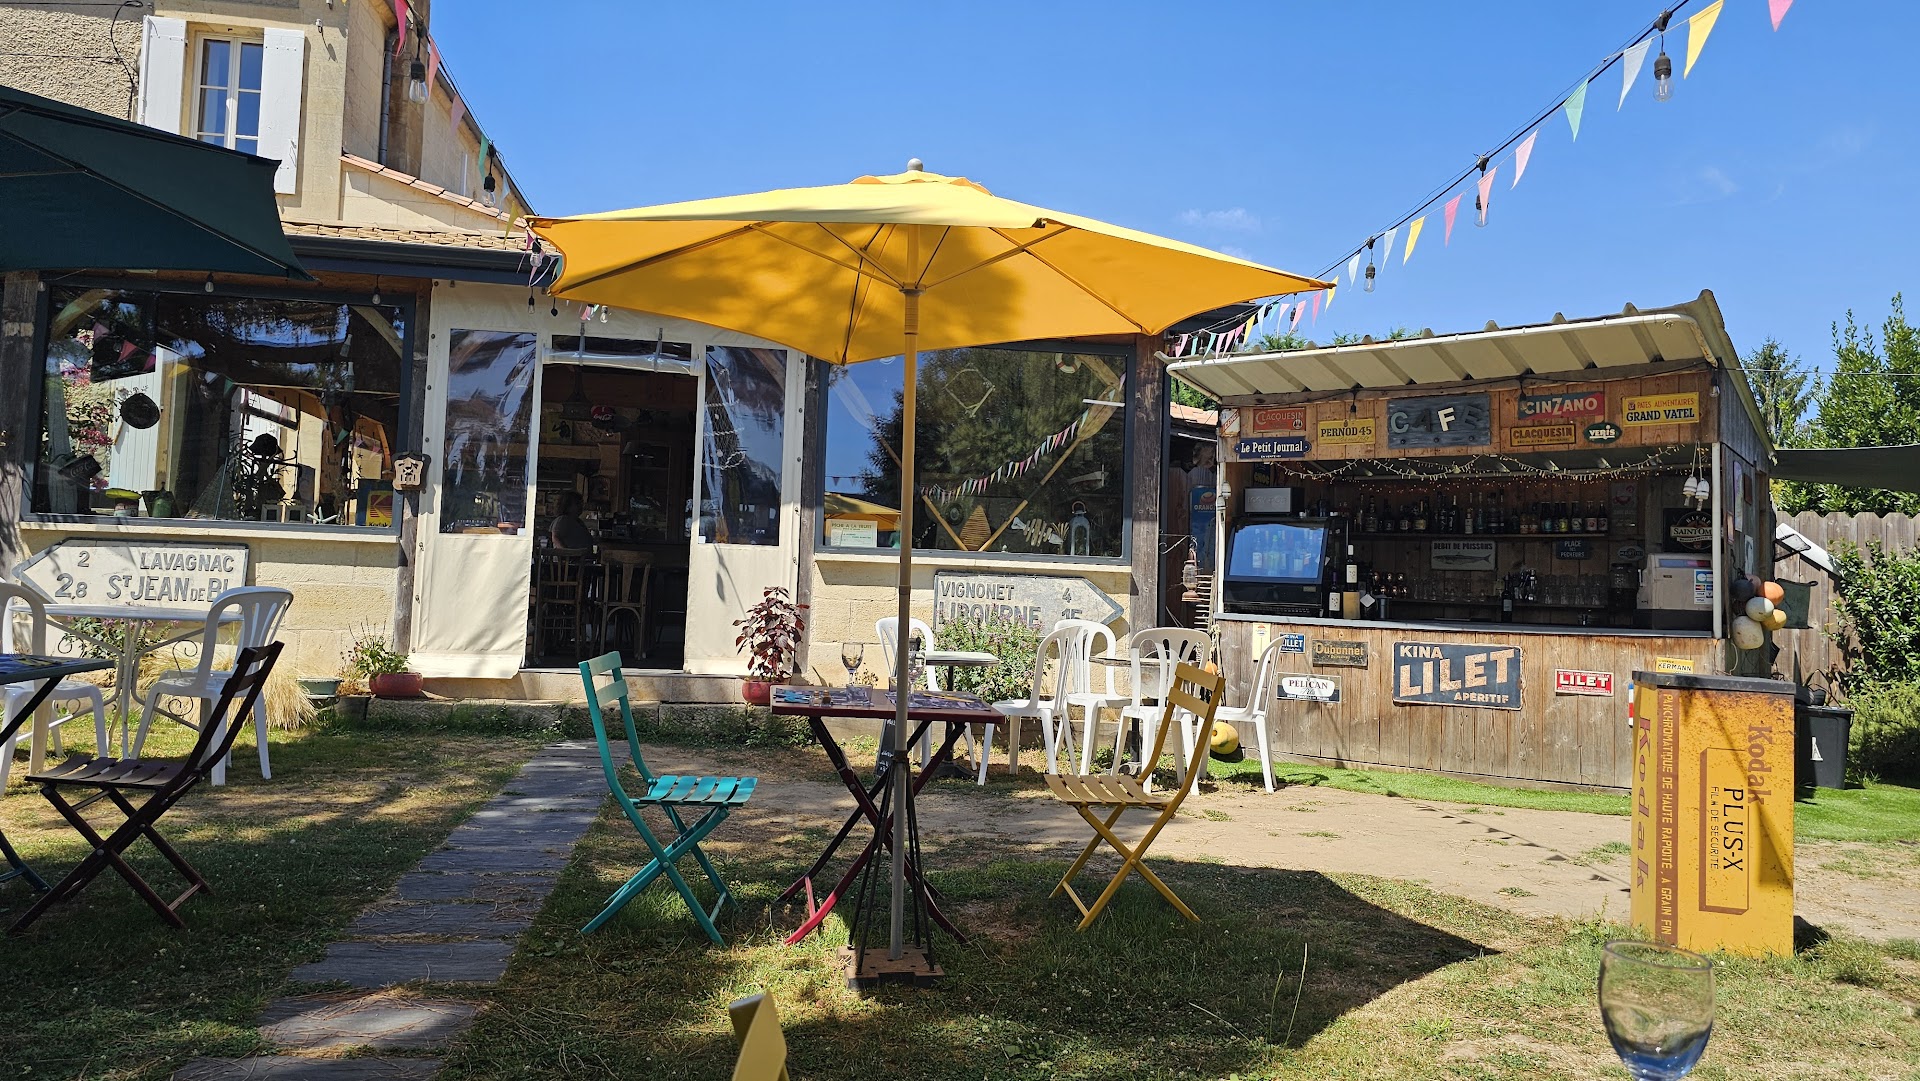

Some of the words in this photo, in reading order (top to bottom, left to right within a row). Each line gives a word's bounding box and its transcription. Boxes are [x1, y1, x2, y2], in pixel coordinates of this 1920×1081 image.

[1525, 397, 1597, 416] CINZANO
[1655, 398, 1694, 408] ALIMENTAIRES
[1255, 411, 1304, 425] CLACQUESIN
[1626, 410, 1661, 422] GRAND
[1663, 408, 1695, 420] VATEL
[1321, 427, 1358, 437] PERNOD
[1359, 426, 1372, 435] 45
[1512, 427, 1573, 440] CLACQUESIN
[1241, 443, 1251, 453] Le
[1252, 442, 1271, 453] Petit
[1273, 440, 1303, 454] Journal
[1453, 542, 1461, 550] DE
[1462, 542, 1493, 550] POISSONS
[77, 551, 90, 568] 2
[140, 551, 235, 573] LAVAGNAC
[131, 576, 190, 601] JEAN
[190, 587, 206, 602] DE
[940, 580, 1015, 601] VIGNONET
[1061, 587, 1072, 603] 4
[1315, 642, 1364, 656] Dubonnet
[1400, 645, 1444, 660] KINA
[1400, 648, 1515, 698] LILET
[1658, 662, 1692, 672] KERMANN
[1559, 674, 1609, 687] LILET
[1661, 693, 1674, 773] PANCHROMATIQUE
[1747, 725, 1773, 805] Kodak
[1662, 777, 1673, 790] DE
[1710, 786, 1719, 806] FILM
[1637, 716, 1651, 893] Kodak
[1662, 793, 1673, 824] HAUTE
[1710, 809, 1719, 822] DE
[1723, 787, 1744, 871] PLUS-X
[1661, 887, 1672, 916] GRAIN
[1661, 919, 1672, 935] FIN
